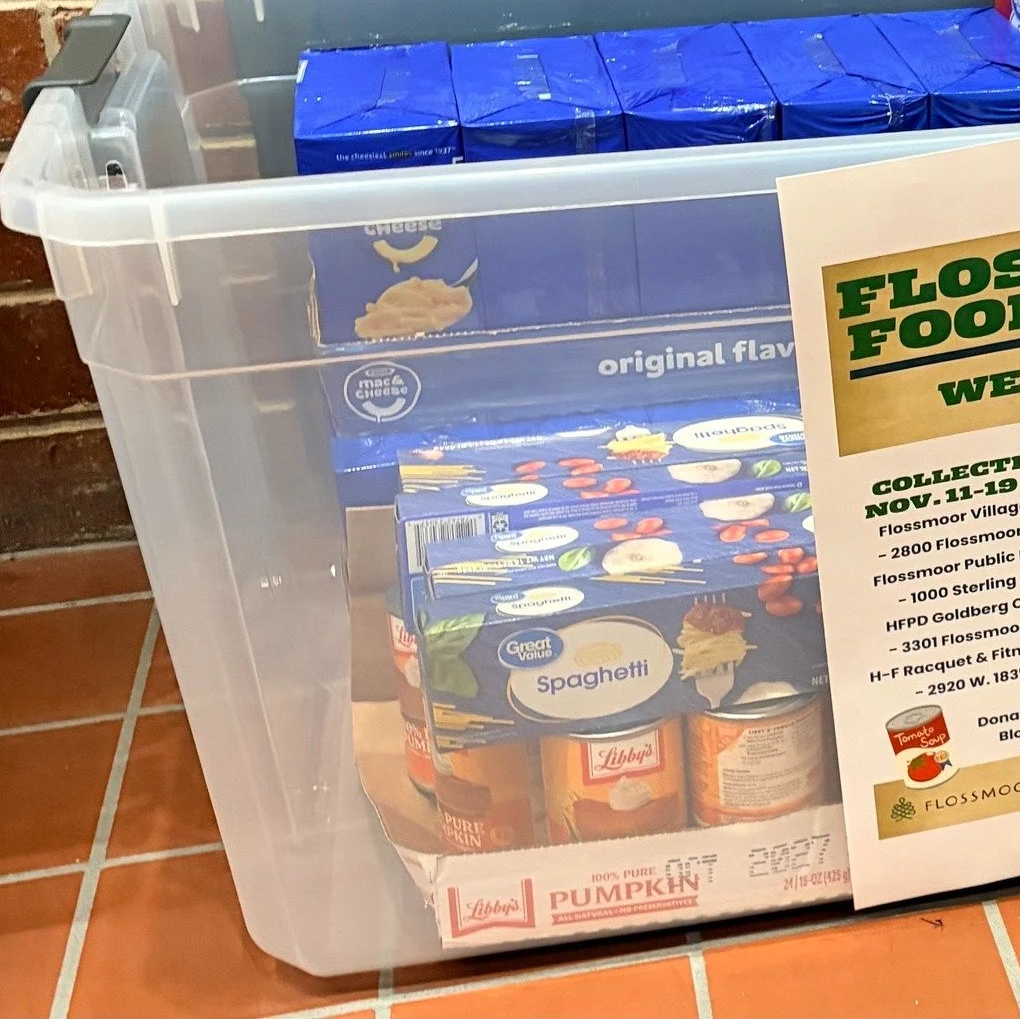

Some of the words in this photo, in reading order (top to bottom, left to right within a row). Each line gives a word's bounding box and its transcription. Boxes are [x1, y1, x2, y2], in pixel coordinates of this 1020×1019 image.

[336, 154, 350, 162] the
[414, 148, 434, 157] since
[597, 343, 725, 379] original
[938, 370, 1020, 406] WE
[865, 493, 942, 519] NOV.
[946, 478, 1018, 502] 11-19
[878, 510, 968, 538] Flossmoor
[890, 541, 932, 560] 2800
[873, 561, 961, 587] Flossmoor
[964, 552, 1016, 572] Public
[910, 587, 948, 604] 1000
[952, 577, 1016, 596] Sterling
[886, 615, 928, 632] HFPD
[932, 601, 1009, 623] Goldberg
[506, 636, 552, 655] Great
[517, 648, 553, 662] Value
[901, 636, 938, 653] 3301
[537, 659, 649, 695] Spaghetti
[870, 668, 900, 682] H-F
[903, 654, 973, 677] Racquet
[976, 652, 988, 664] &
[927, 678, 966, 696] 2920
[969, 675, 990, 688] W.
[894, 726, 935, 746] Tomato
[920, 732, 946, 749] Soup
[594, 743, 652, 770] Libby's
[444, 812, 485, 835] PURE
[591, 871, 618, 882] 100%
[622, 866, 657, 878] PURE
[550, 873, 700, 910] PUMPKIN
[462, 898, 520, 922] Libby's
[558, 913, 573, 923] ALL
